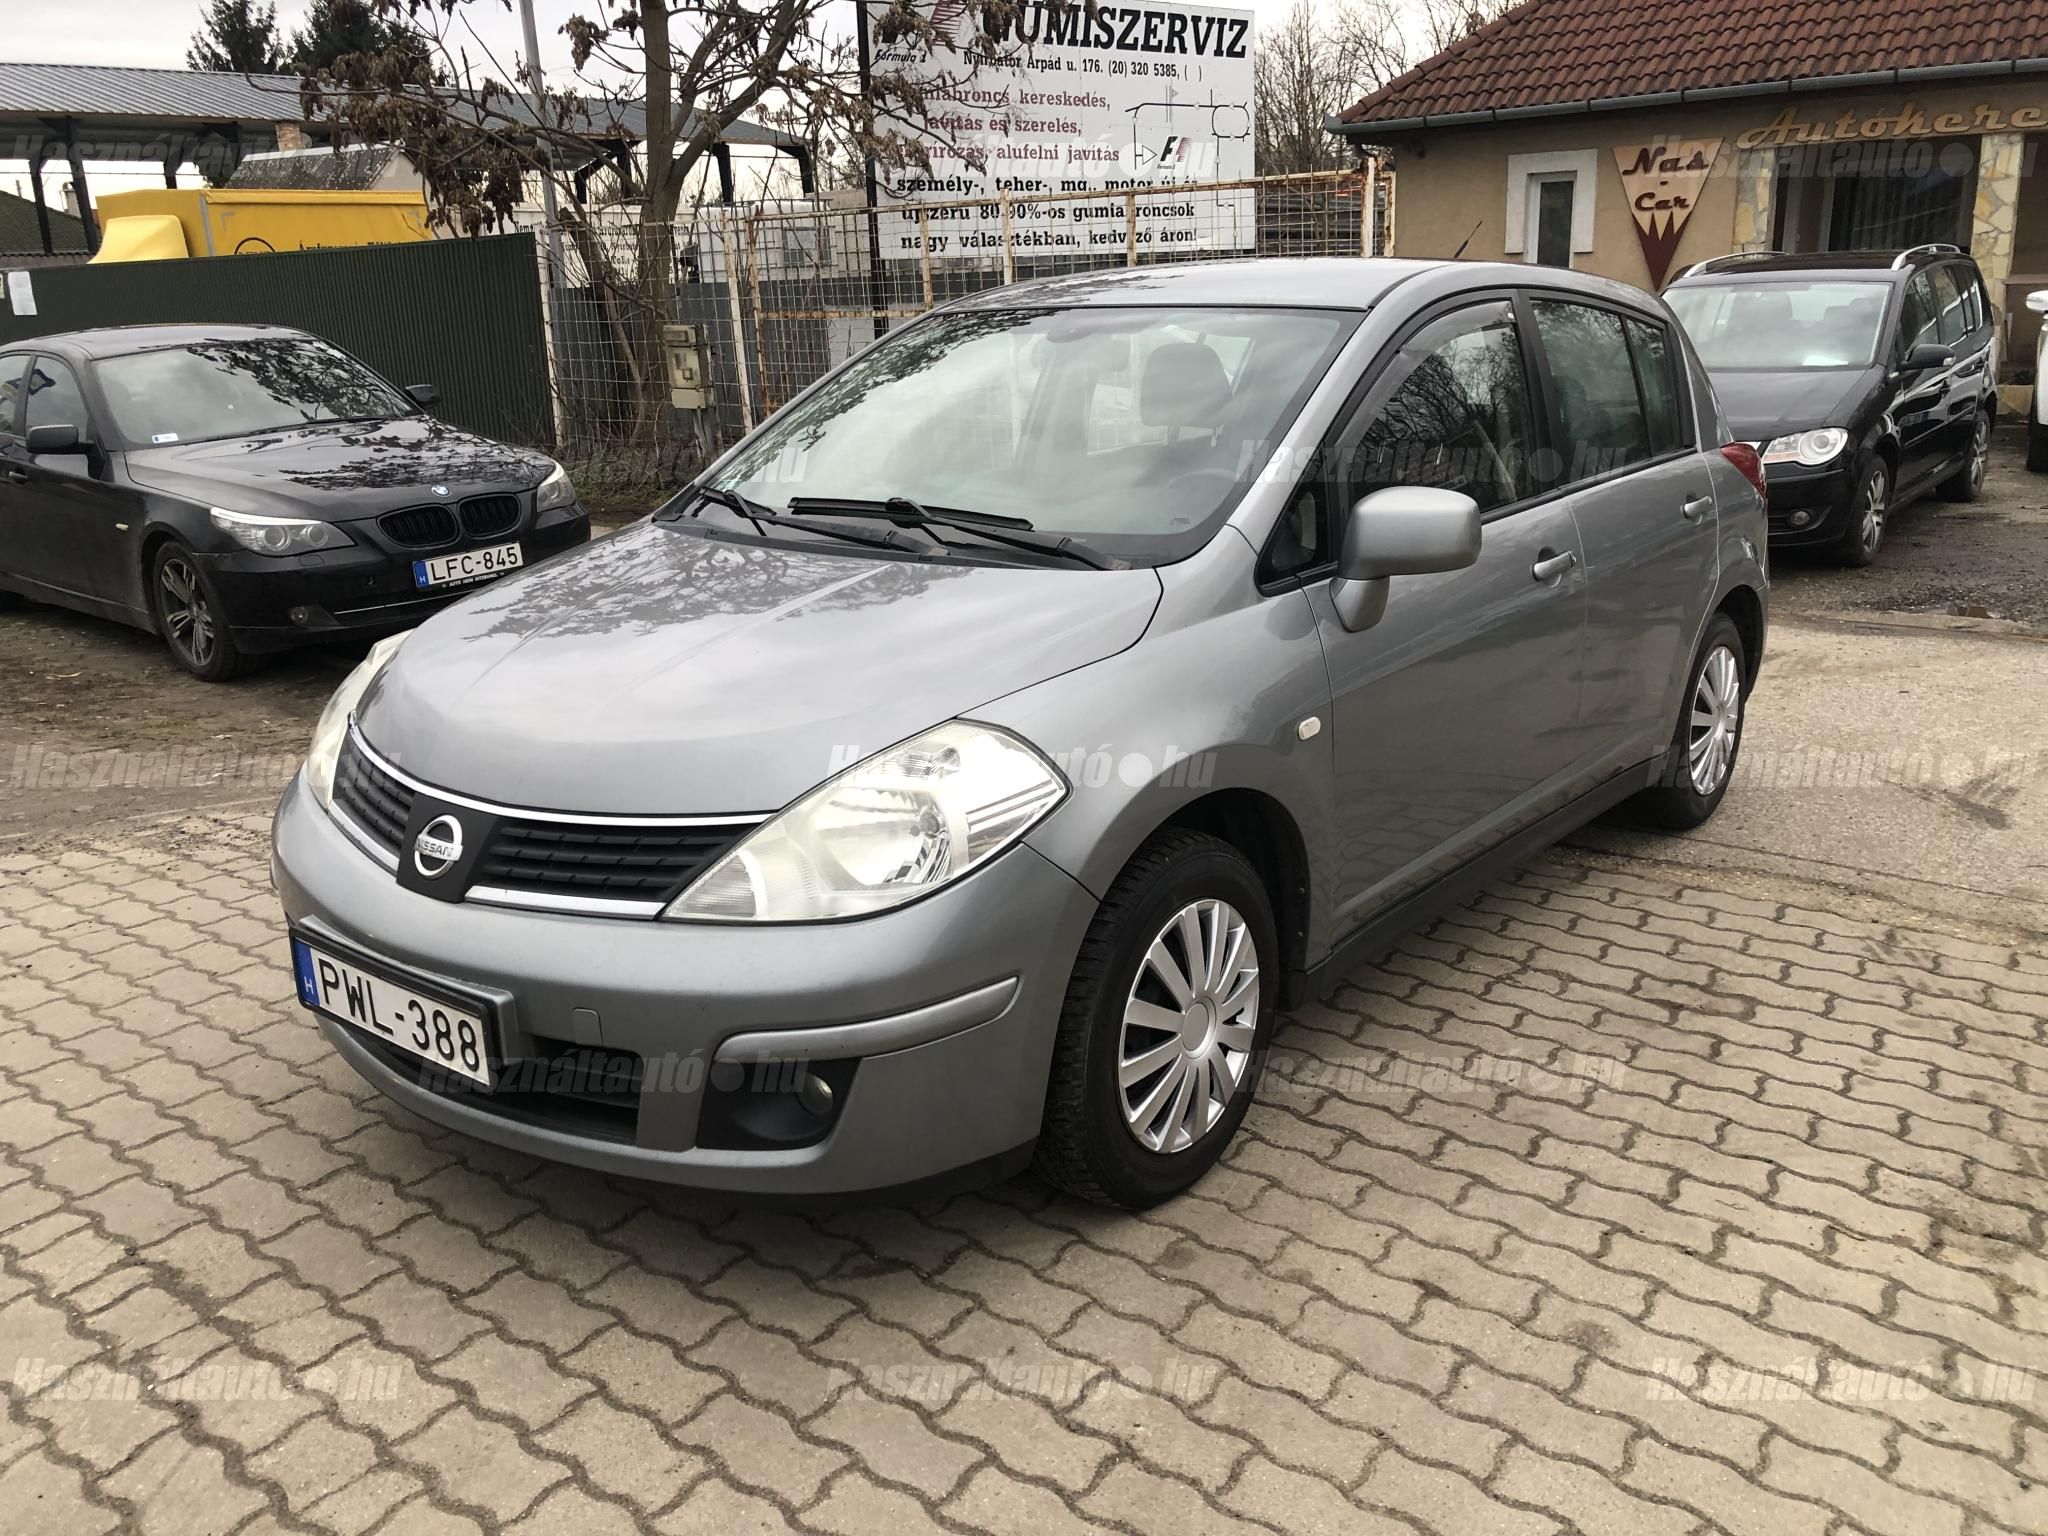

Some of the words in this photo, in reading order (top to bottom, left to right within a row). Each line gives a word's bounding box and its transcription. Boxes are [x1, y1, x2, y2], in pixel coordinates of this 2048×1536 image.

[1066, 61, 1077, 72] u.
[1082, 58, 1103, 73] 176.
[1108, 60, 1128, 78] (20)
[1131, 62, 1149, 76] 320
[1019, 88, 1111, 111] kereskedés,
[1014, 115, 1082, 134] szerelés,
[996, 143, 1059, 160] alufelni
[1067, 145, 1120, 164] javítás
[1622, 146, 1710, 176] Nas
[1073, 202, 1195, 222] gumiaroncsok
[1634, 192, 1691, 212] Car
[901, 235, 949, 252] nagy
[1089, 227, 1152, 245] kedvző
[430, 546, 518, 581] LFC-845
[416, 837, 454, 857] NISSAN
[304, 976, 314, 994] H
[318, 957, 480, 1072] PWL-388
